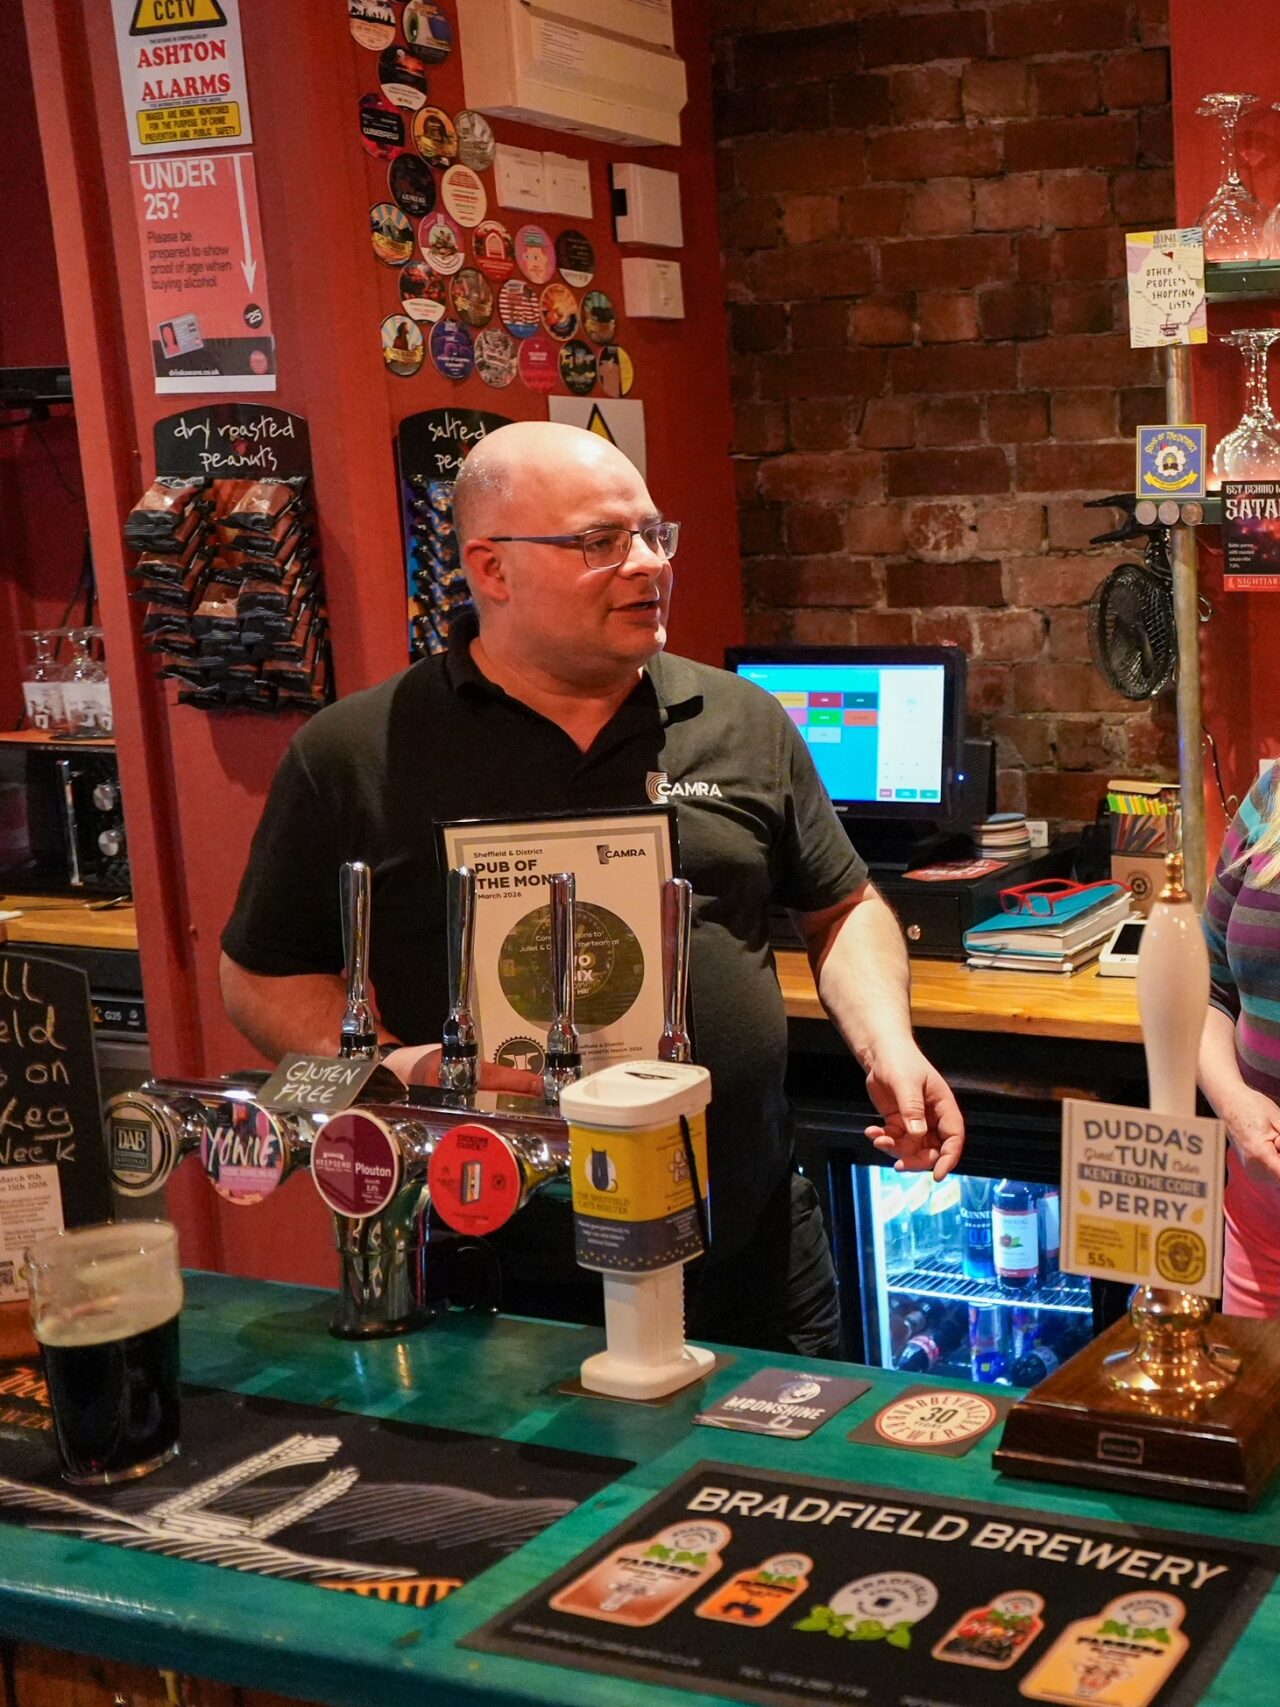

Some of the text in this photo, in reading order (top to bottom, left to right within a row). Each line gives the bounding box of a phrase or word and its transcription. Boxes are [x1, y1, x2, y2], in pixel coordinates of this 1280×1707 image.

[154, 0, 195, 20] CCTV
[137, 40, 226, 68] ASHTON
[142, 73, 231, 101] ALARMS
[146, 131, 177, 142] PREVENTION
[139, 159, 217, 190] UNDER
[143, 192, 180, 220] 25?
[147, 230, 193, 243] Please be
[149, 245, 229, 261] prepared show
[150, 261, 232, 276] proof age when
[1146, 267, 1173, 277] OTHER
[151, 276, 218, 293] buying alcohol
[1146, 278, 1186, 288] PEOPLE'S
[1152, 289, 1195, 300] SHOPPING
[1169, 302, 1191, 310] LISTS
[174, 414, 295, 449] dry roasted
[428, 414, 485, 440] salted
[199, 448, 278, 473] peanuts
[1226, 485, 1244, 495] GET
[1245, 484, 1274, 495] BEHIND
[1237, 577, 1278, 585] NIGHTJAR
[656, 781, 723, 798] CAMRA
[473, 850, 507, 859] Sheffield
[605, 848, 646, 859] CAMRA
[474, 859, 538, 874] PUB OF
[477, 877, 510, 890] THE
[504, 891, 522, 899] 2026
[26, 1061, 69, 1085] on
[285, 1060, 361, 1086] GLUTEN
[273, 1083, 338, 1104] FREE
[118, 1129, 146, 1151] DAB
[1084, 1119, 1204, 1155] DUDDA'S
[1115, 1145, 1168, 1171] TUN
[354, 1162, 392, 1178] Plouton
[1084, 1167, 1200, 1196] KENT TO THE CORE
[1098, 1190, 1188, 1222] PERRY
[1088, 1252, 1115, 1268] 5.5%
[722, 1396, 826, 1420] MOONSHINE
[919, 1406, 956, 1424] 30
[686, 1485, 1230, 1592] BRADFIELD BREWERY
[850, 1577, 929, 1608] BRADFIELD
